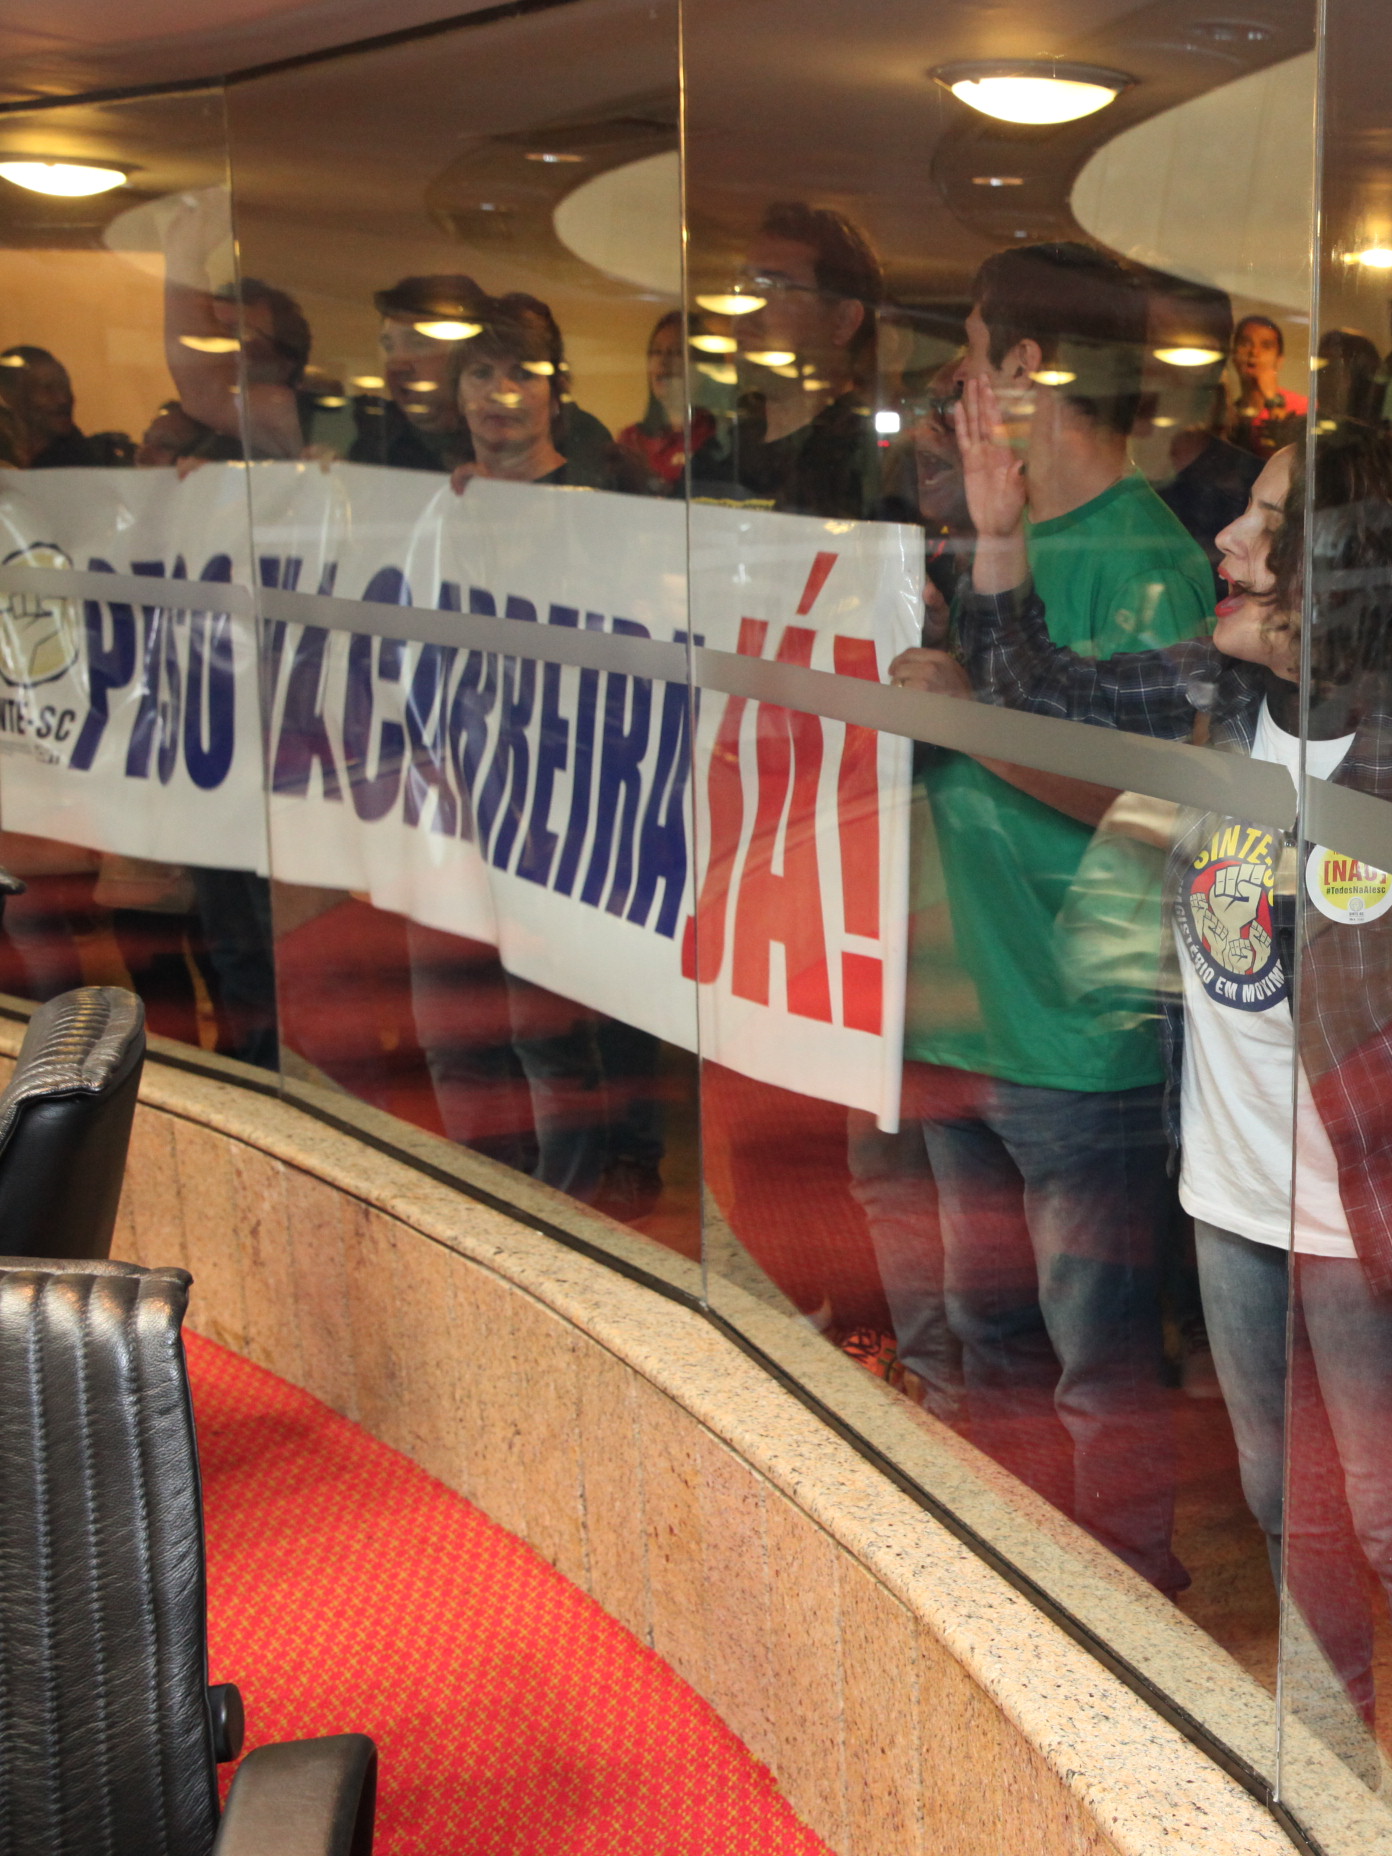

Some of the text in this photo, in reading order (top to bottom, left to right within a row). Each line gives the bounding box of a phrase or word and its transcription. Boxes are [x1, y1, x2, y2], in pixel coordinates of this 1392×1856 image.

[681, 551, 884, 1037] JÁ!
[1326, 886, 1386, 895] #TodosNaAlesc
[1215, 976, 1238, 1001] EM
[1242, 958, 1285, 1003] MOVIM
